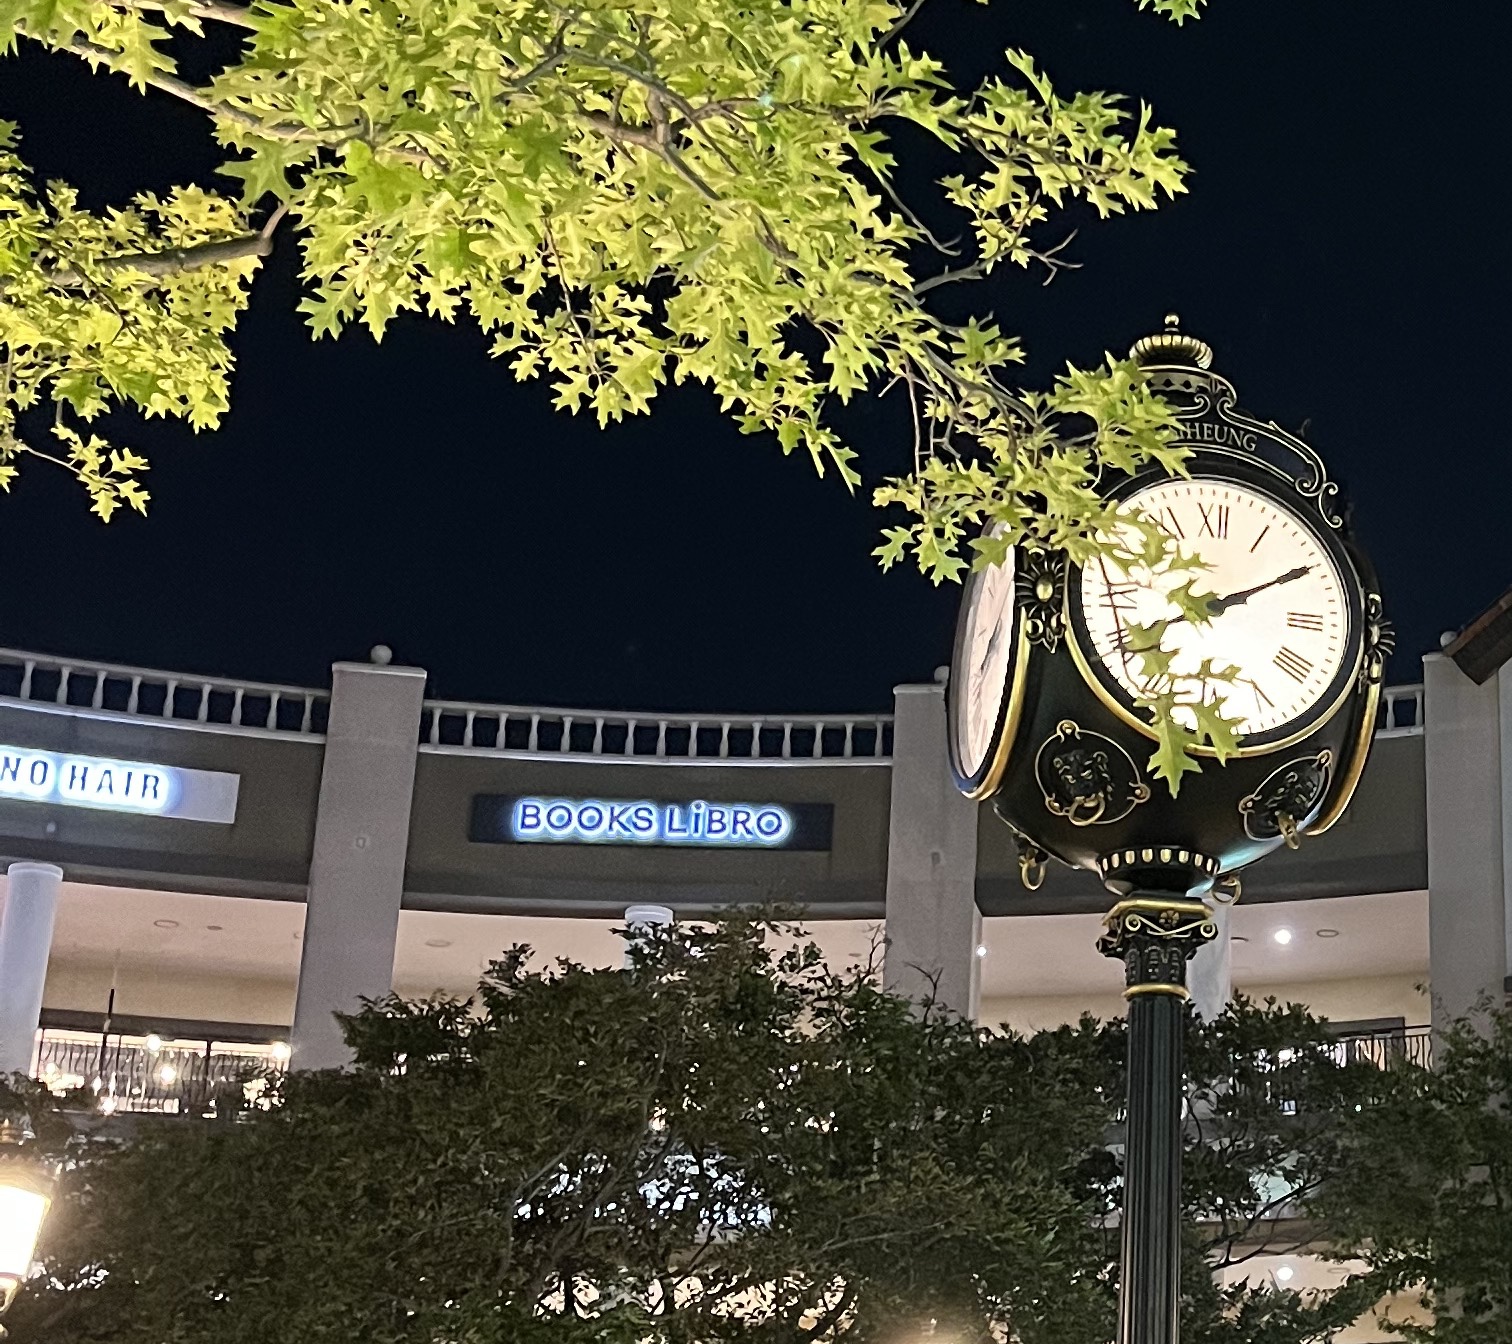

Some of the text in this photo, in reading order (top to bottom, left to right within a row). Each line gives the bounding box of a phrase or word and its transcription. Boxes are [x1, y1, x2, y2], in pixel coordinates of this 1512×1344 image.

[1197, 502, 1230, 540] XII
[68, 763, 161, 800] HAIR
[519, 802, 654, 834] BOOKS
